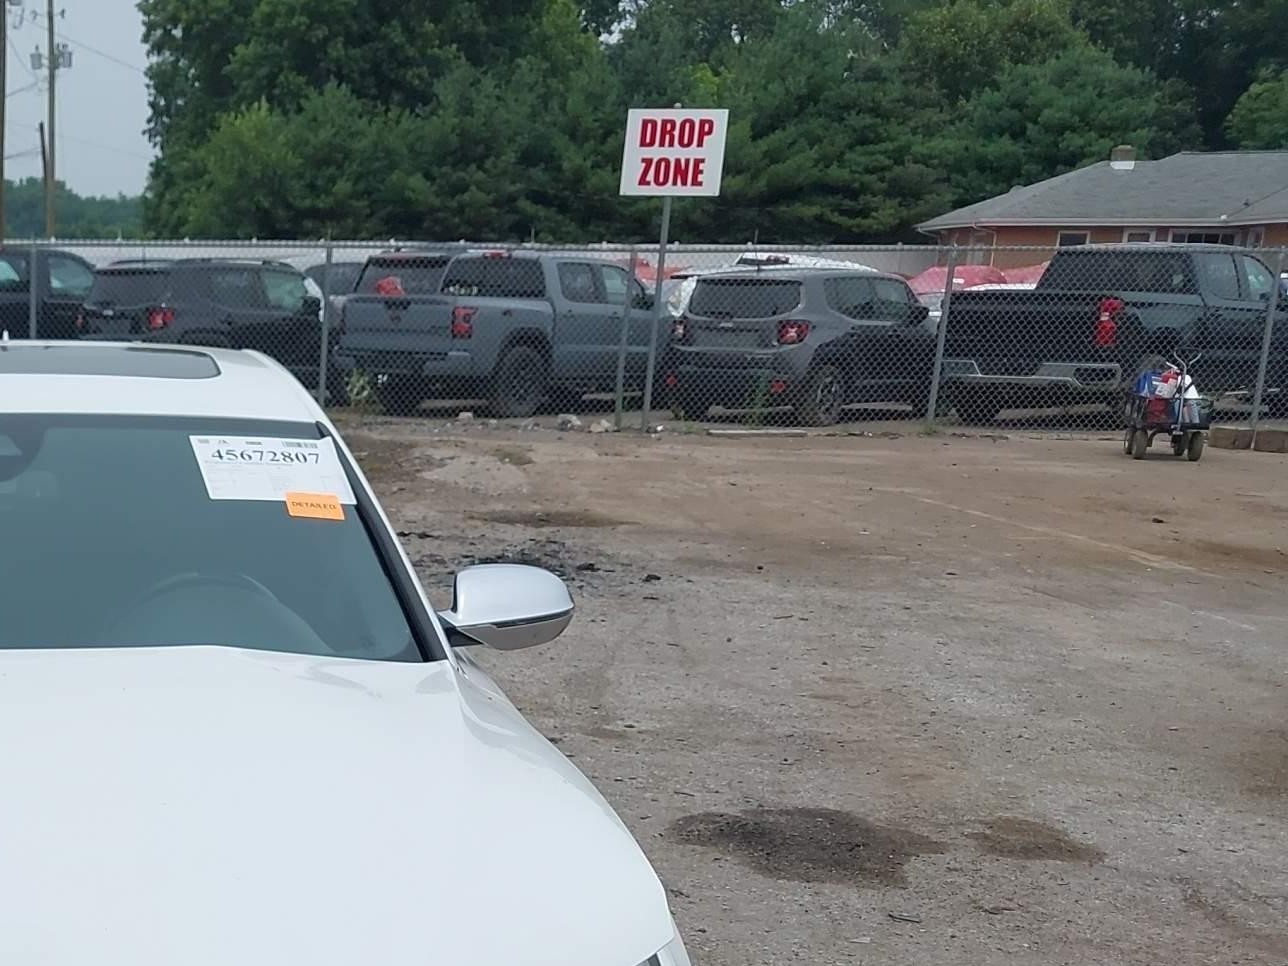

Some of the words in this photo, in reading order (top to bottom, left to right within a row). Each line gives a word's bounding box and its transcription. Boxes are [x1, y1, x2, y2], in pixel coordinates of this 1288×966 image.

[639, 118, 714, 148] DROP
[638, 157, 706, 187] ZONE
[211, 448, 320, 465] 45672807
[291, 501, 337, 510] DETAILED
